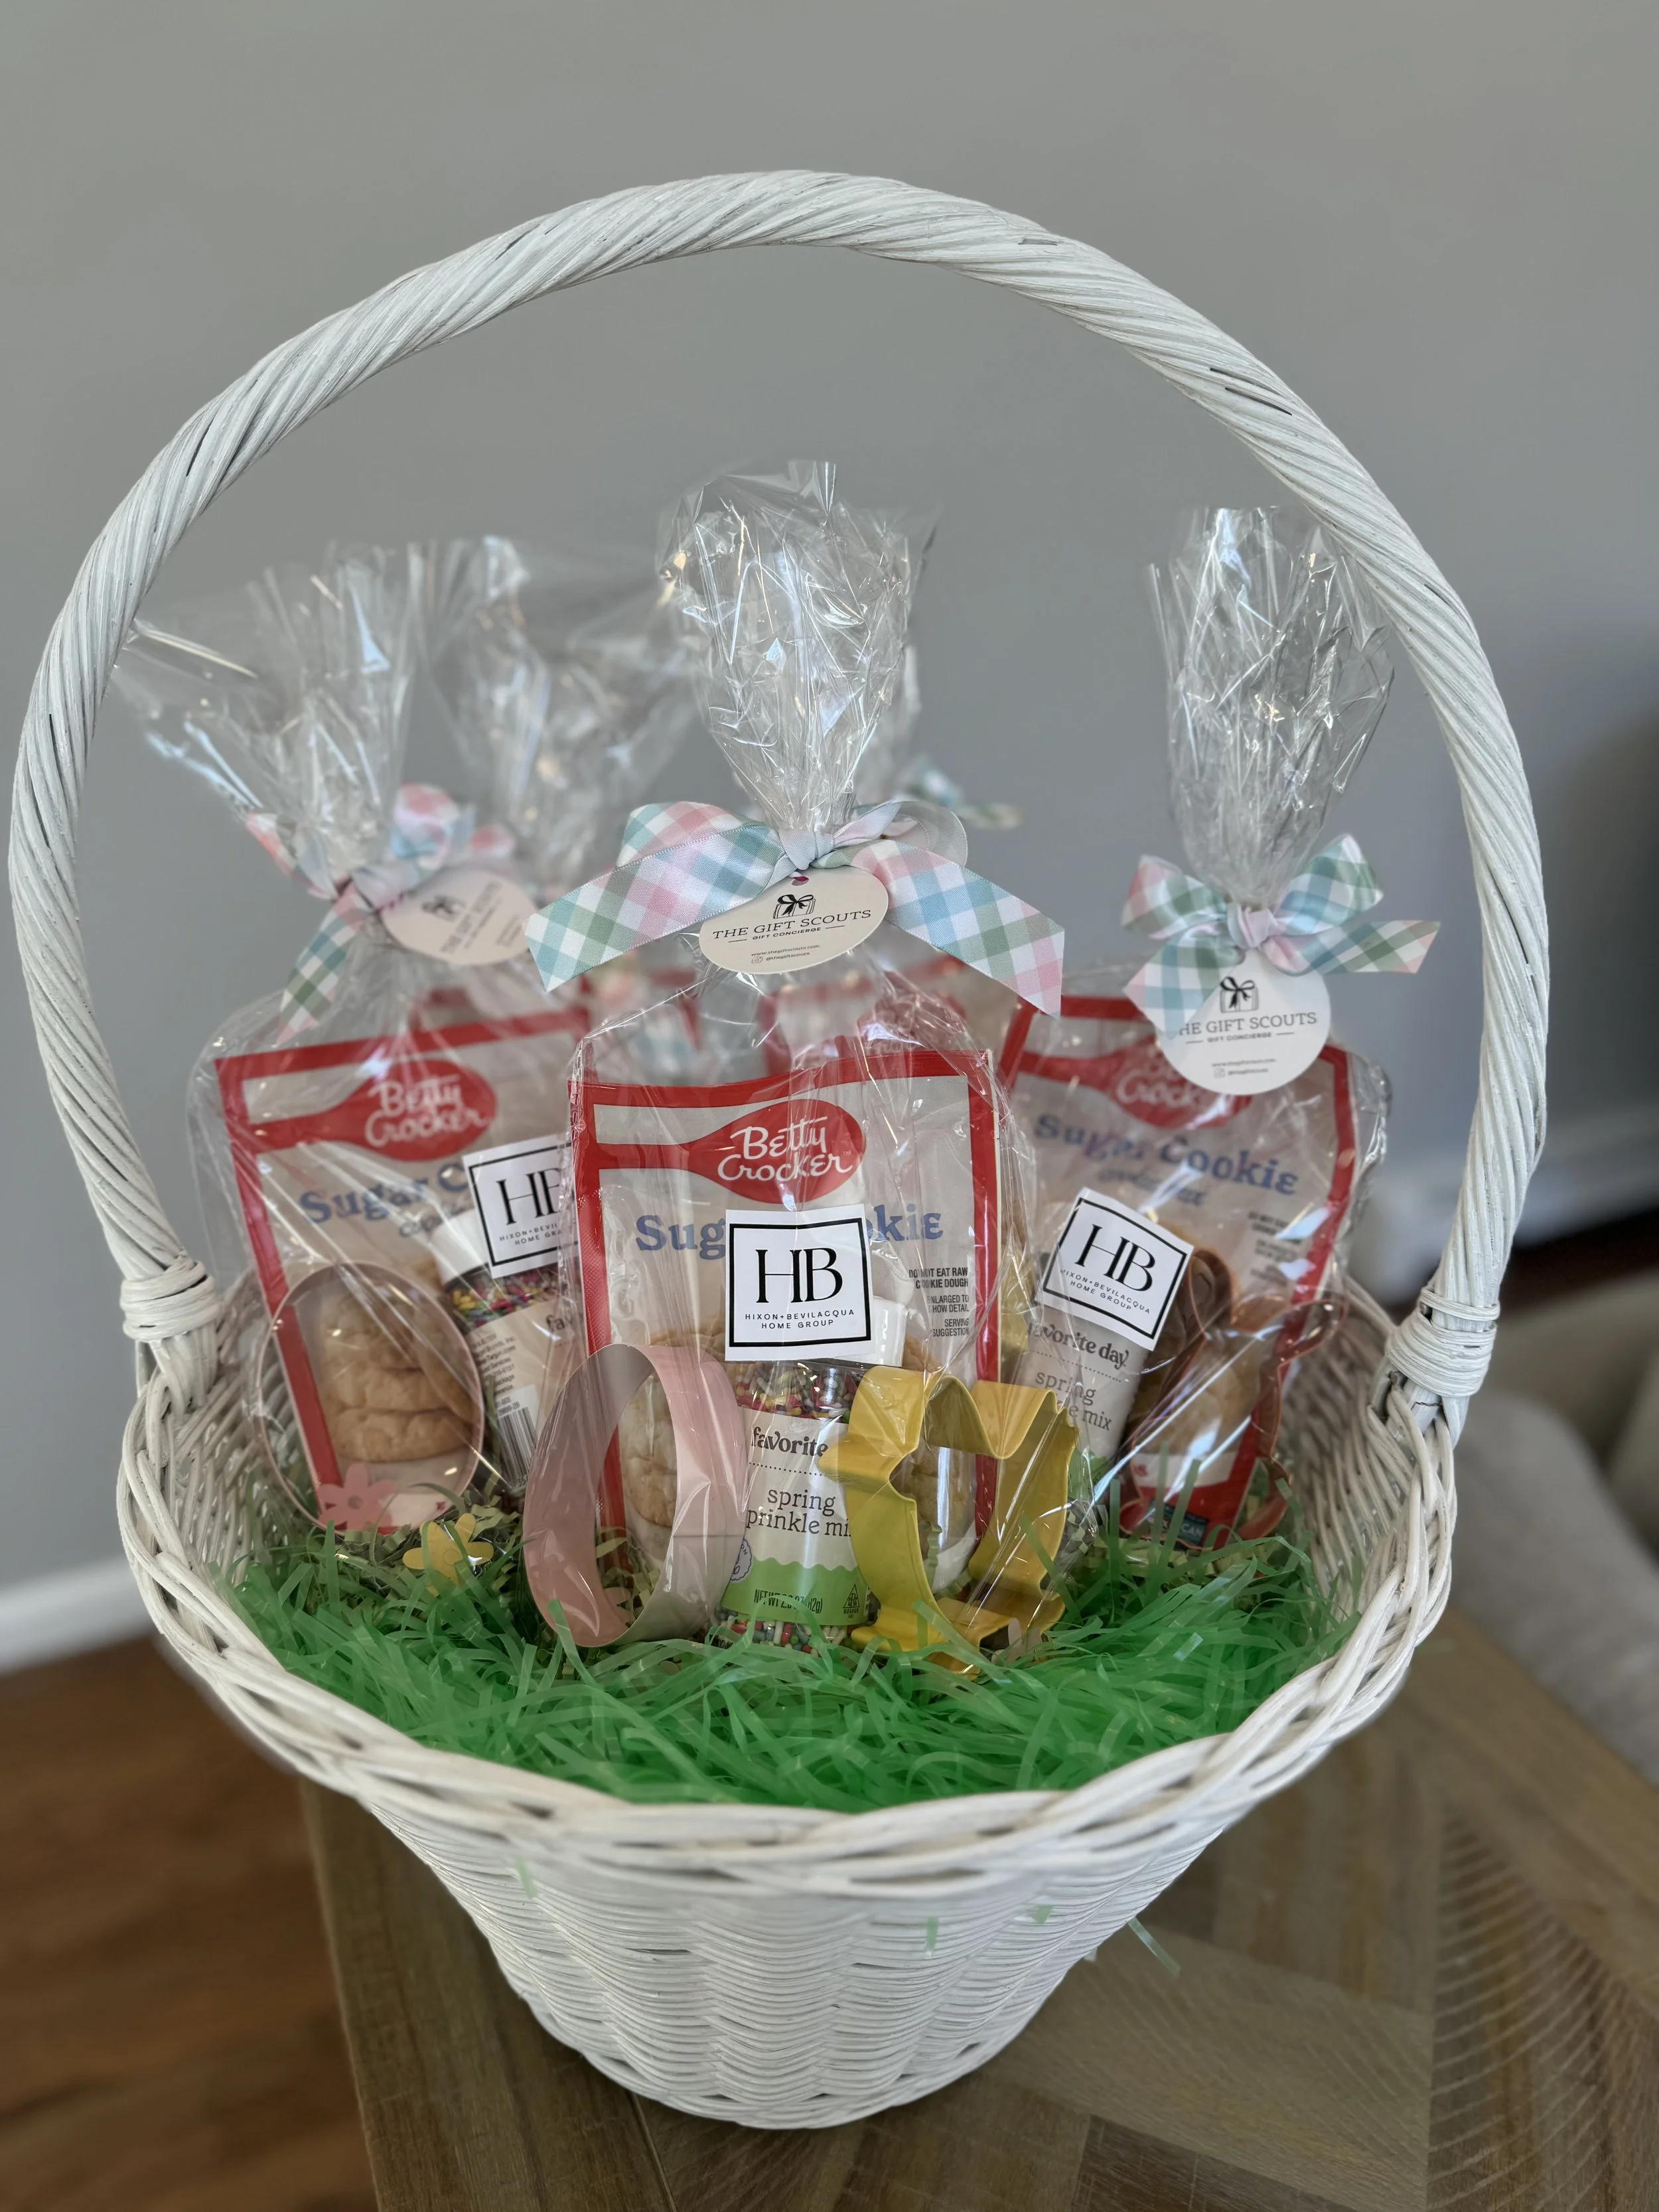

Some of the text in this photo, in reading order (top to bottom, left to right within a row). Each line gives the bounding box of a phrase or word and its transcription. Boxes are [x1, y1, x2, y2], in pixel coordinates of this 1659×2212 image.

[713, 910, 872, 939] THE GIFT SCOUTS
[772, 927, 822, 938] CONCIERGE
[751, 944, 820, 957] www.thegiftscouts.com
[1179, 1012, 1317, 1036] HE GIFT SCOUTS
[1226, 1031, 1272, 1041] CONCIERGE
[368, 1073, 463, 1117] Betty
[365, 1104, 492, 1147] Crocker
[730, 1116, 828, 1159] Betty
[717, 1150, 853, 1182] Crocker
[1160, 1133, 1299, 1195] Cookie
[299, 1177, 429, 1224] Sugar
[500, 1222, 559, 1241] HIXON+BEVIL
[514, 1234, 540, 1246] HOME
[635, 1204, 944, 1260] Sug kie
[1074, 1223, 1156, 1292] HB
[756, 1247, 843, 1303] HB
[908, 1269, 918, 1278] DO
[936, 1268, 950, 1277] EAT
[952, 1267, 968, 1276] RAW
[944, 1278, 968, 1288] DOUGH
[949, 1303, 970, 1313] DETAIL
[1070, 1280, 1133, 1311] HOME GROUP
[798, 1319, 835, 1328] GROUP
[932, 1327, 969, 1337] SUGGESTION
[944, 1318, 969, 1327] SERVING
[1099, 1343, 1129, 1370] day
[1035, 1371, 1096, 1406] spring
[1083, 1407, 1112, 1431] mix
[751, 1426, 829, 1457] favorite
[767, 1489, 835, 1516] spring
[746, 1509, 852, 1537] prinkle mi
